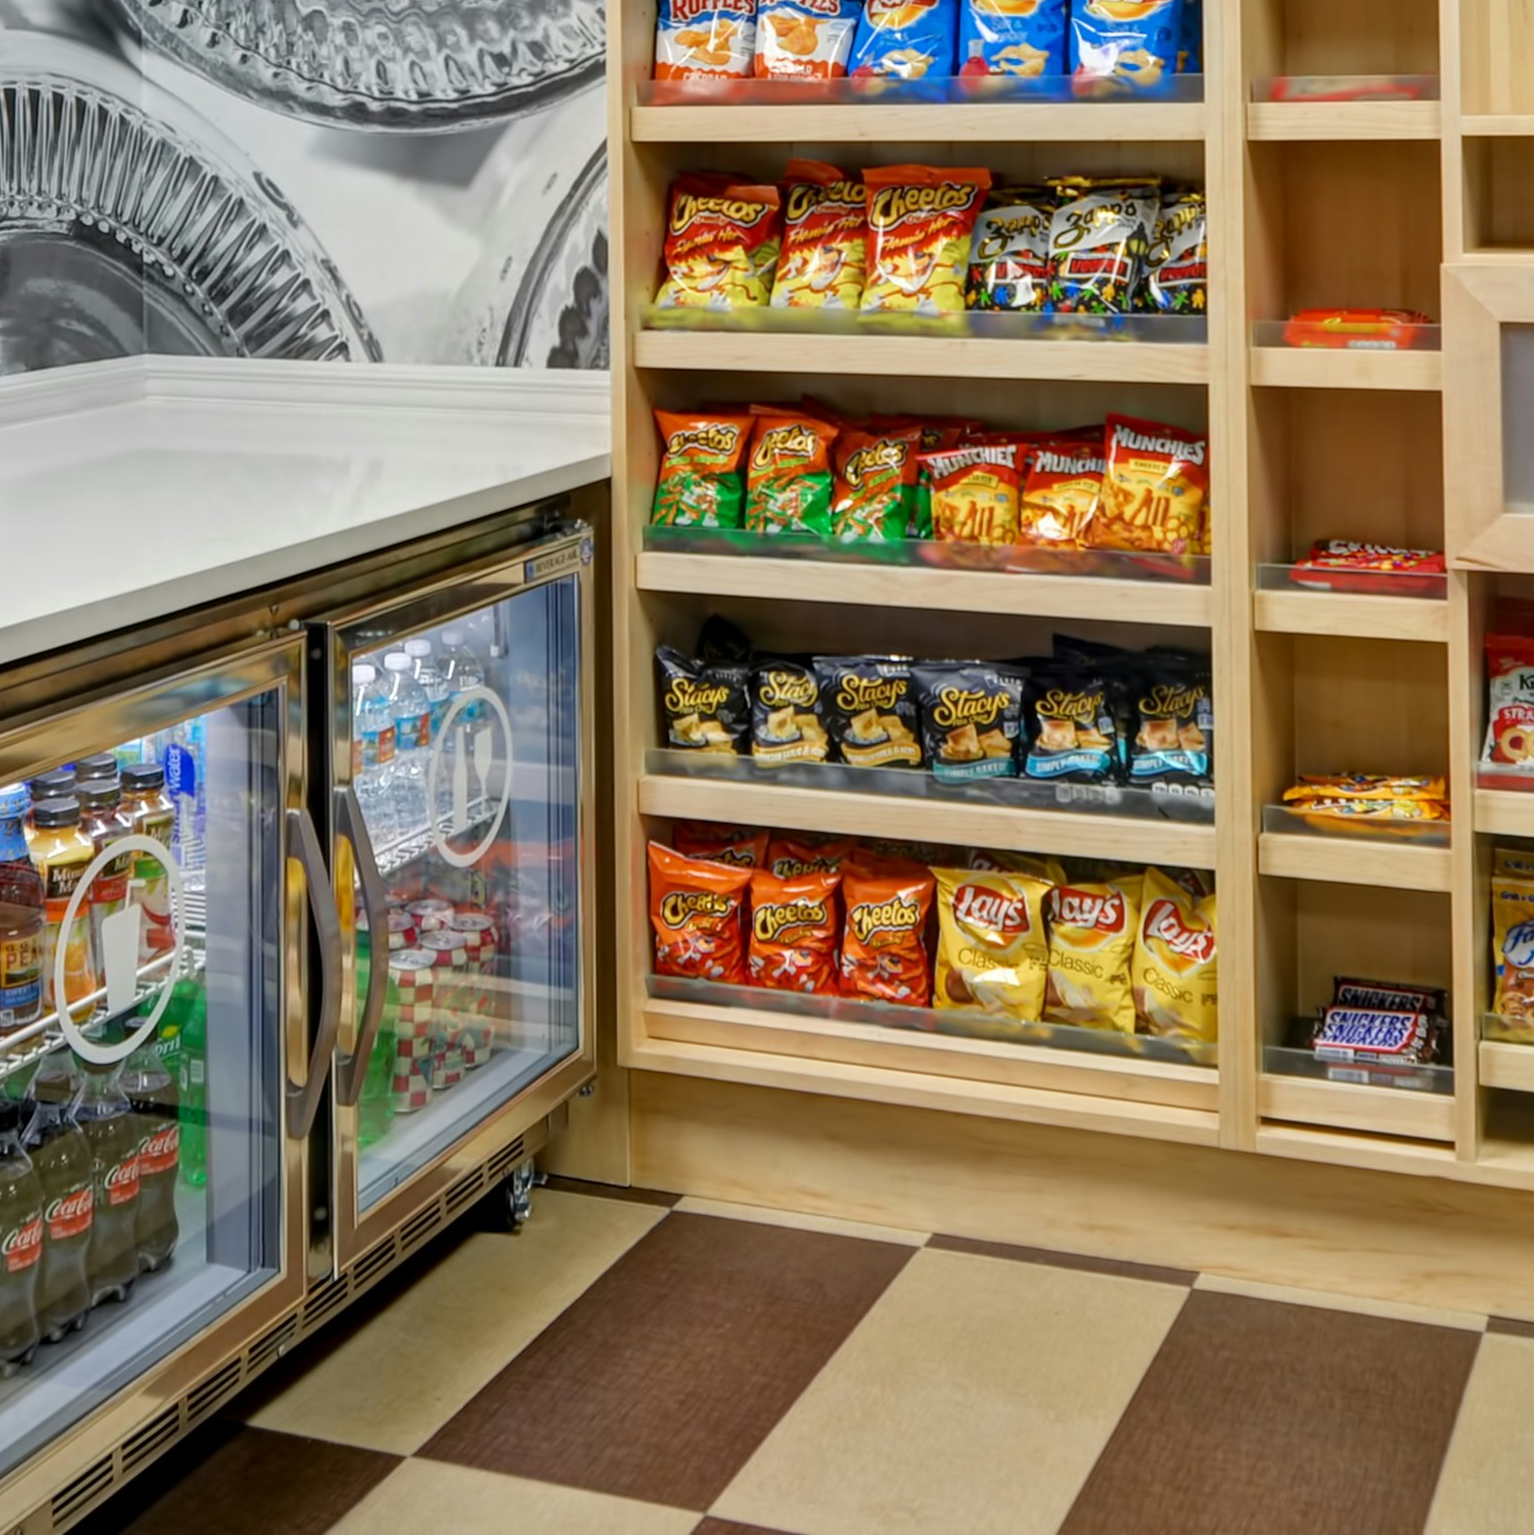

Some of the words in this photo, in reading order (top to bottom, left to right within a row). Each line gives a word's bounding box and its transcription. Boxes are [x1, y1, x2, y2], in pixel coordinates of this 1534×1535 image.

[671, 193, 762, 231] Cheetos
[787, 181, 866, 220] Cheeto
[871, 183, 974, 230] Cheetos
[927, 445, 1016, 479] MUNCHIES
[1036, 450, 1106, 475] MUNCHI
[1114, 424, 1205, 465] MUNCHIES
[666, 677, 729, 713] Stacy's
[760, 671, 817, 706] Stacy
[837, 673, 907, 711] Stacy's
[934, 686, 1011, 726] Stacy's
[662, 893, 729, 926] Cheetos
[755, 902, 825, 941] Cheetos
[852, 901, 919, 942] Cheetos
[957, 888, 1025, 932] Lay's
[1148, 903, 1215, 965] Lay's
[1048, 949, 1104, 979] Classic
[1143, 967, 1193, 1003] Classic
